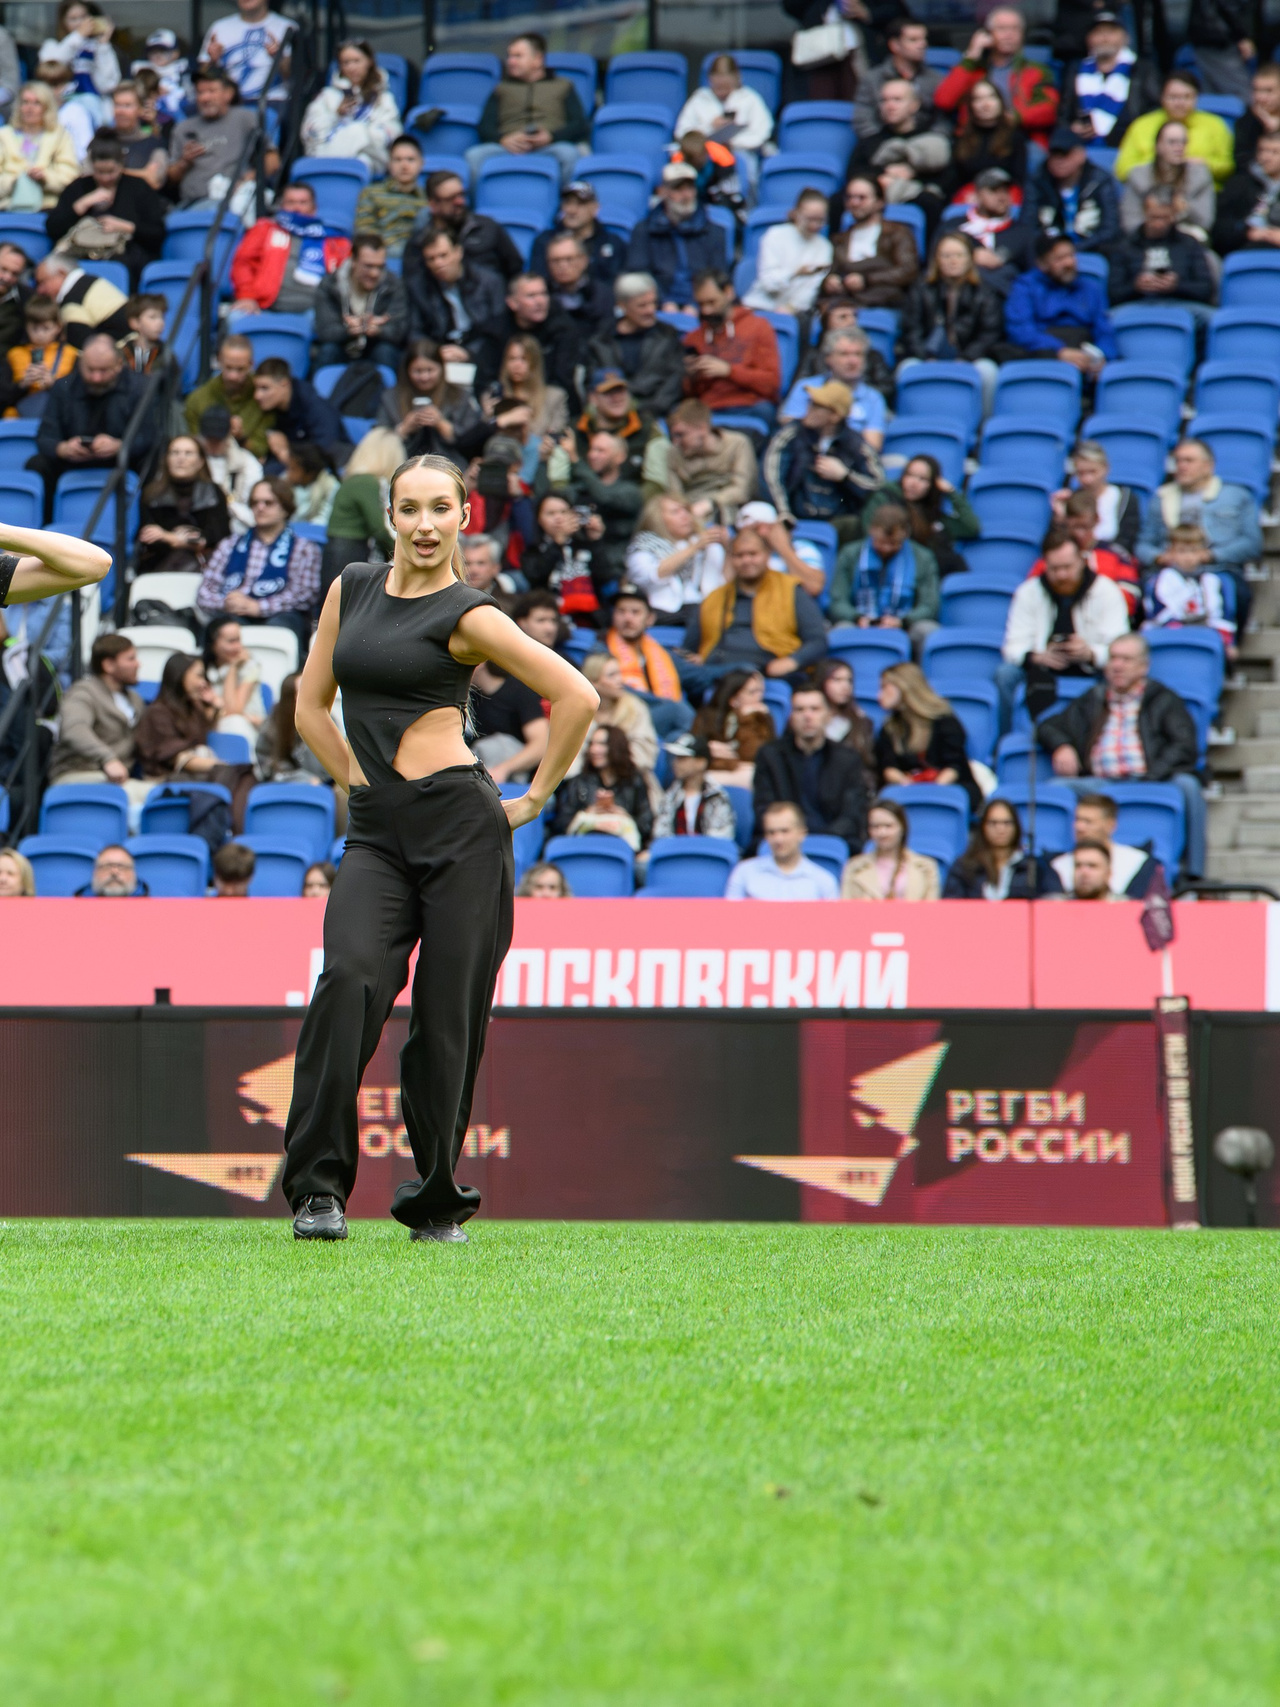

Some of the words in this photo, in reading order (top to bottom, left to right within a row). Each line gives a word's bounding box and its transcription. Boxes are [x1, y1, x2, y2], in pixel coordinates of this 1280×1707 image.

[493, 932, 909, 1008] ОСКОВСКИЙ
[946, 1090, 1086, 1125] РЕГБИ
[946, 1127, 1132, 1164] РОССИИ
